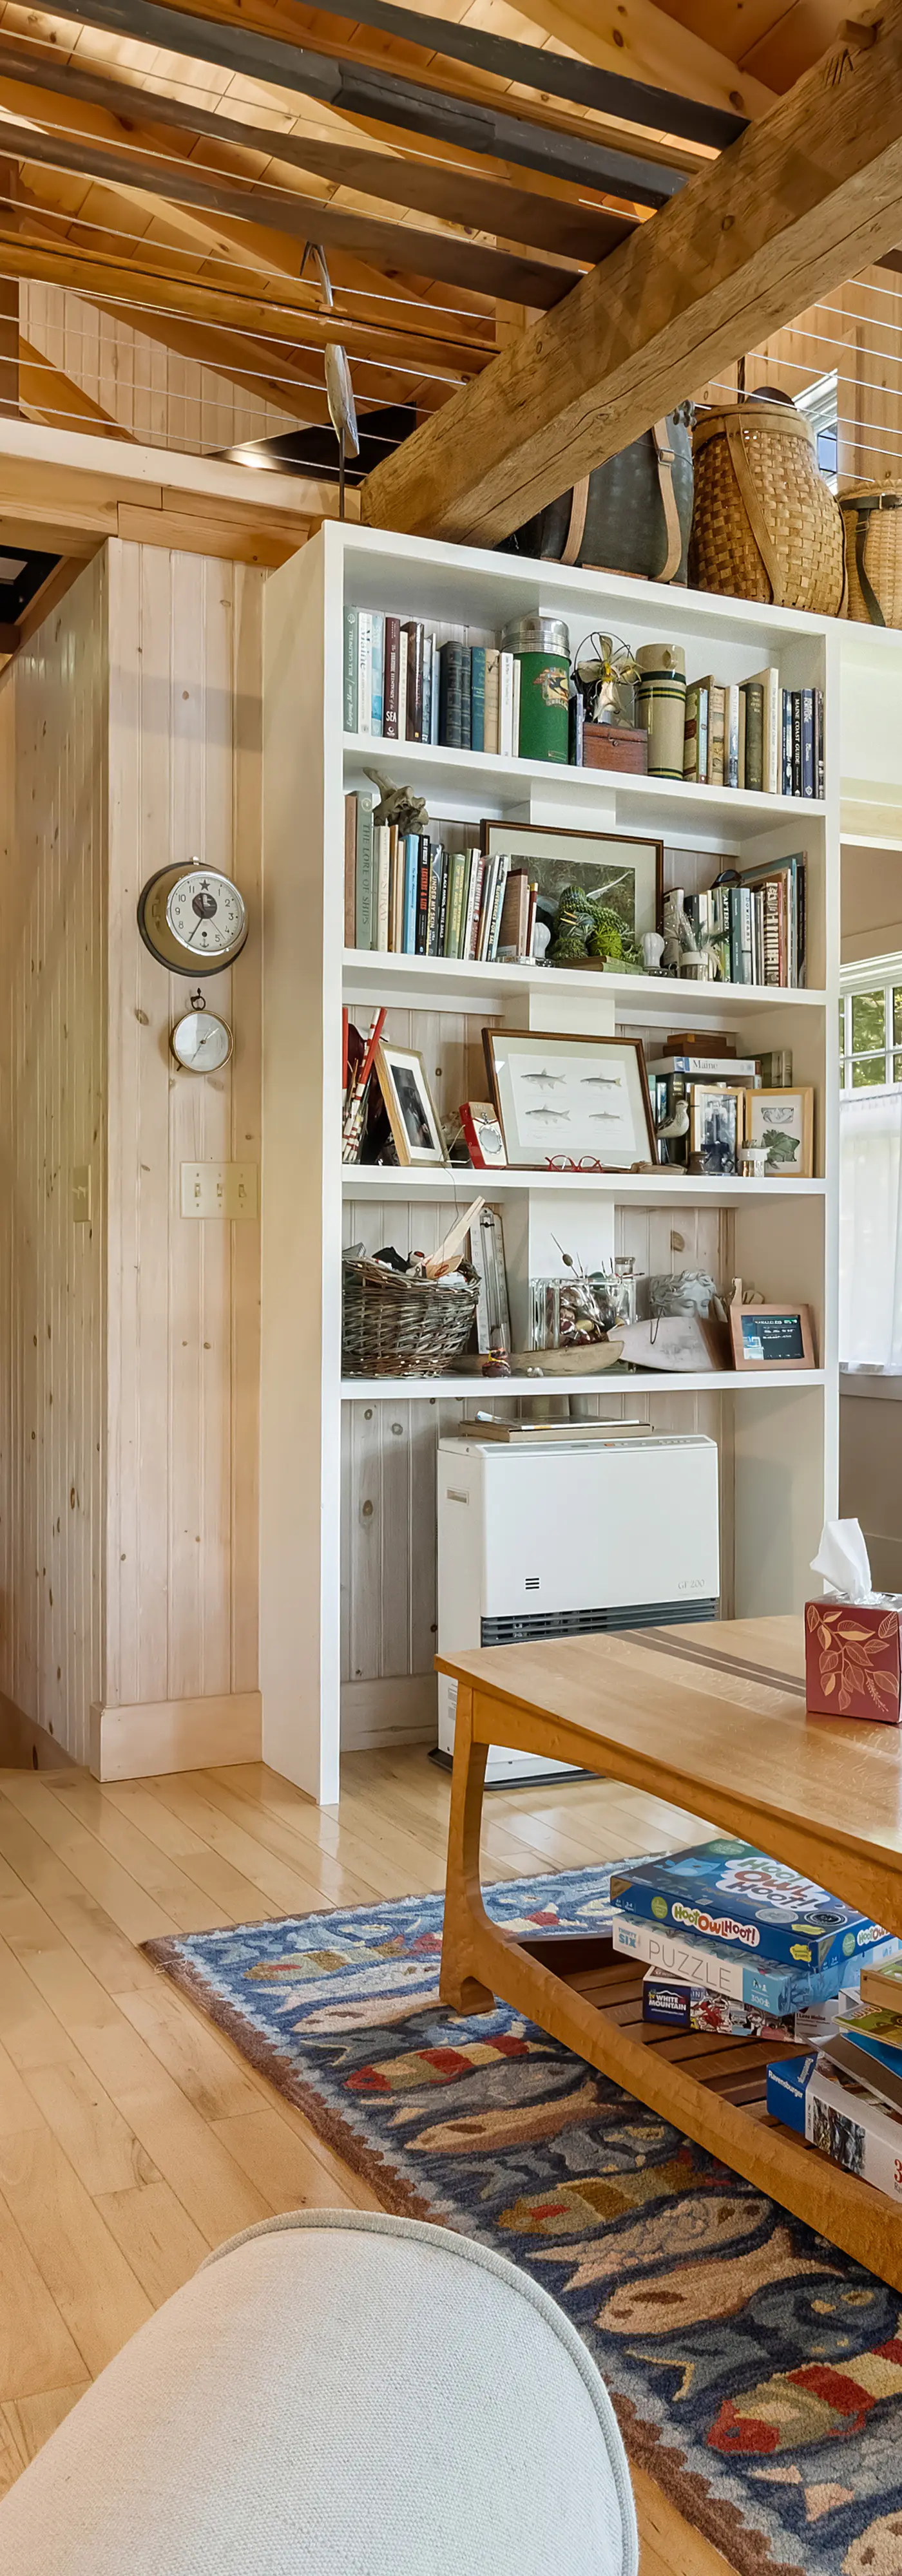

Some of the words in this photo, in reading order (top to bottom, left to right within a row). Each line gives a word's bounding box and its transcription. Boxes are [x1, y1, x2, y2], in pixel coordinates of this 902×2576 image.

[386, 710, 397, 723] SEA
[189, 885, 195, 894] 11
[362, 878, 370, 893] OF
[178, 894, 186, 902] 10
[224, 898, 231, 907] 2
[430, 900, 436, 911] MY
[175, 907, 180, 915] 9
[228, 912, 234, 921] 3
[178, 920, 184, 929] 8
[224, 925, 230, 934] 4
[215, 934, 221, 943] 5
[693, 1059, 718, 1070] Maine
[619, 1935, 637, 1949] SIX
[648, 1939, 731, 1993] PUZZLE
[656, 1994, 678, 2003] WHITE
[648, 1998, 687, 2011] MOUNTAIN
[768, 2069, 803, 2099] Ravensburger
